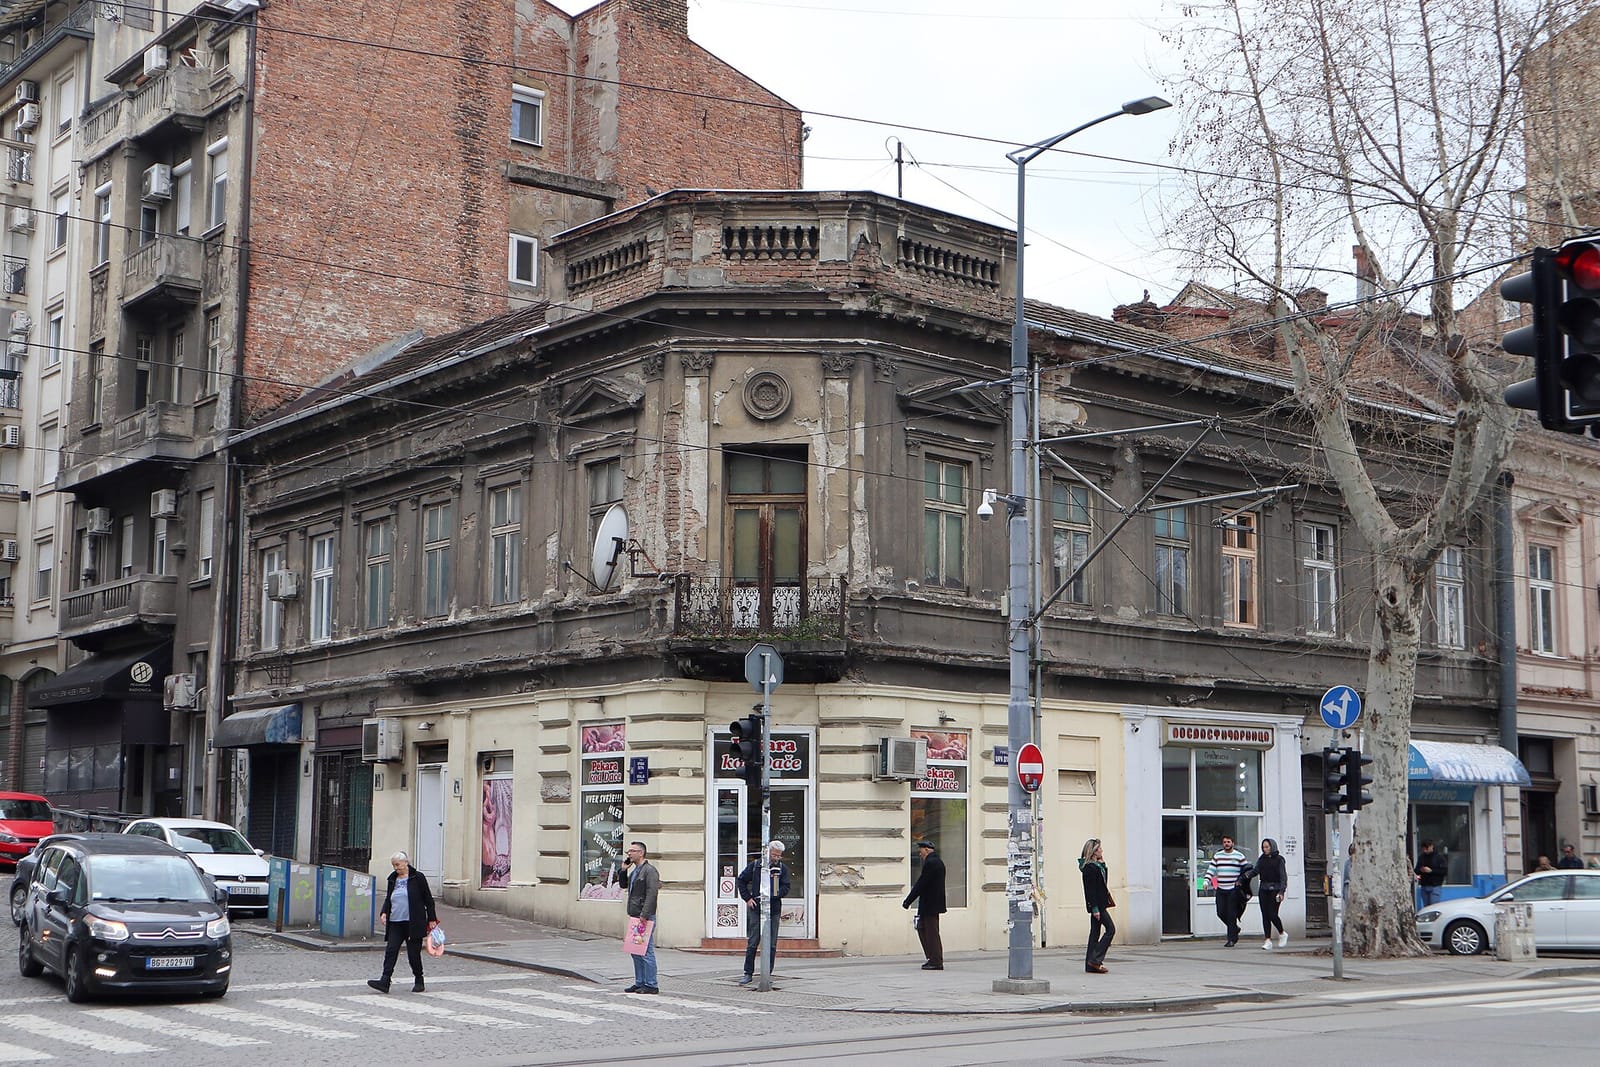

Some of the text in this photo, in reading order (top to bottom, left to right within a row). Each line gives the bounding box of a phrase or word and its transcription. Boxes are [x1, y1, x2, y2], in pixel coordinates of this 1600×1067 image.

[1172, 727, 1270, 743] ПОСЛАСТИЧАРНИЦА
[591, 760, 618, 772] Pekara
[769, 754, 802, 771] ače
[588, 772, 603, 783] kod
[926, 767, 955, 780] ekara
[915, 778, 934, 790] kod
[607, 804, 623, 819] HLEB
[585, 811, 605, 829] PECIVO
[584, 857, 603, 872] BUREK
